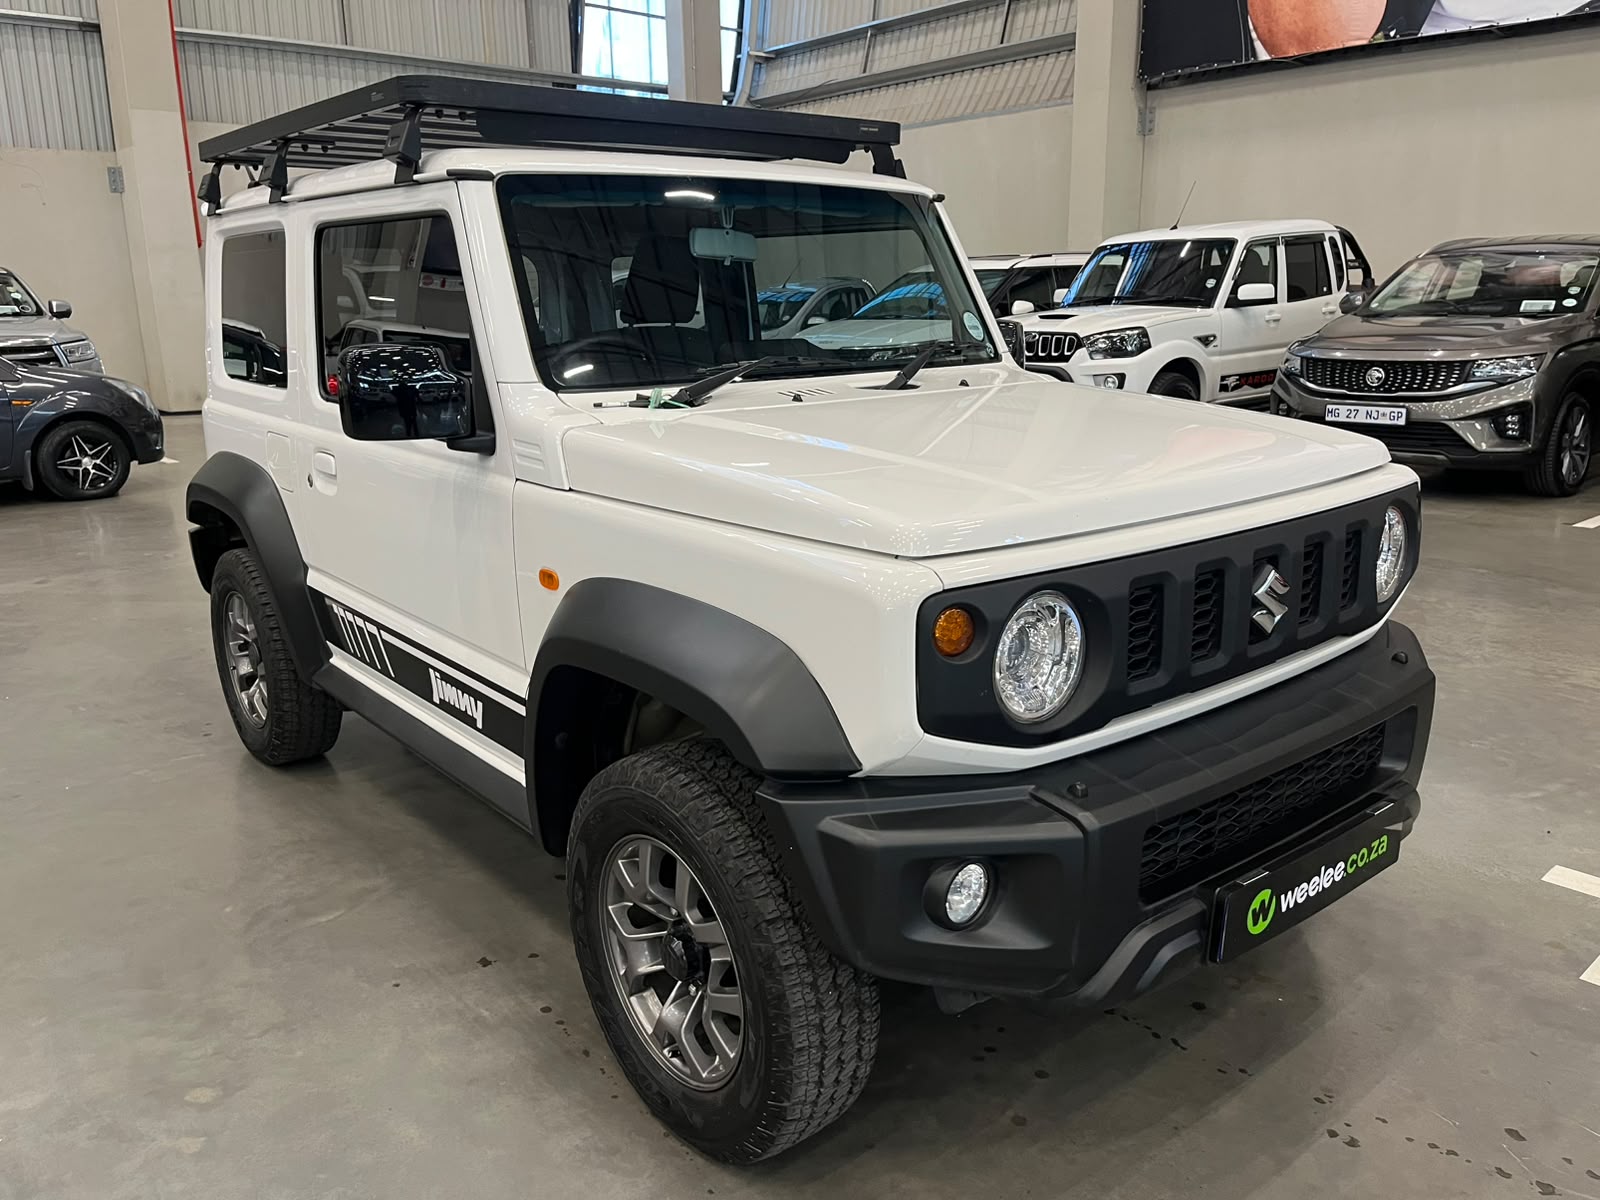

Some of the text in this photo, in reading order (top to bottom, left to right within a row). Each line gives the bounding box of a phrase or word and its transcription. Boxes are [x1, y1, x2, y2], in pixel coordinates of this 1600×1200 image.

[1326, 407, 1403, 421] MG 27 NJ GP
[1280, 834, 1388, 912] weelee.co.za
